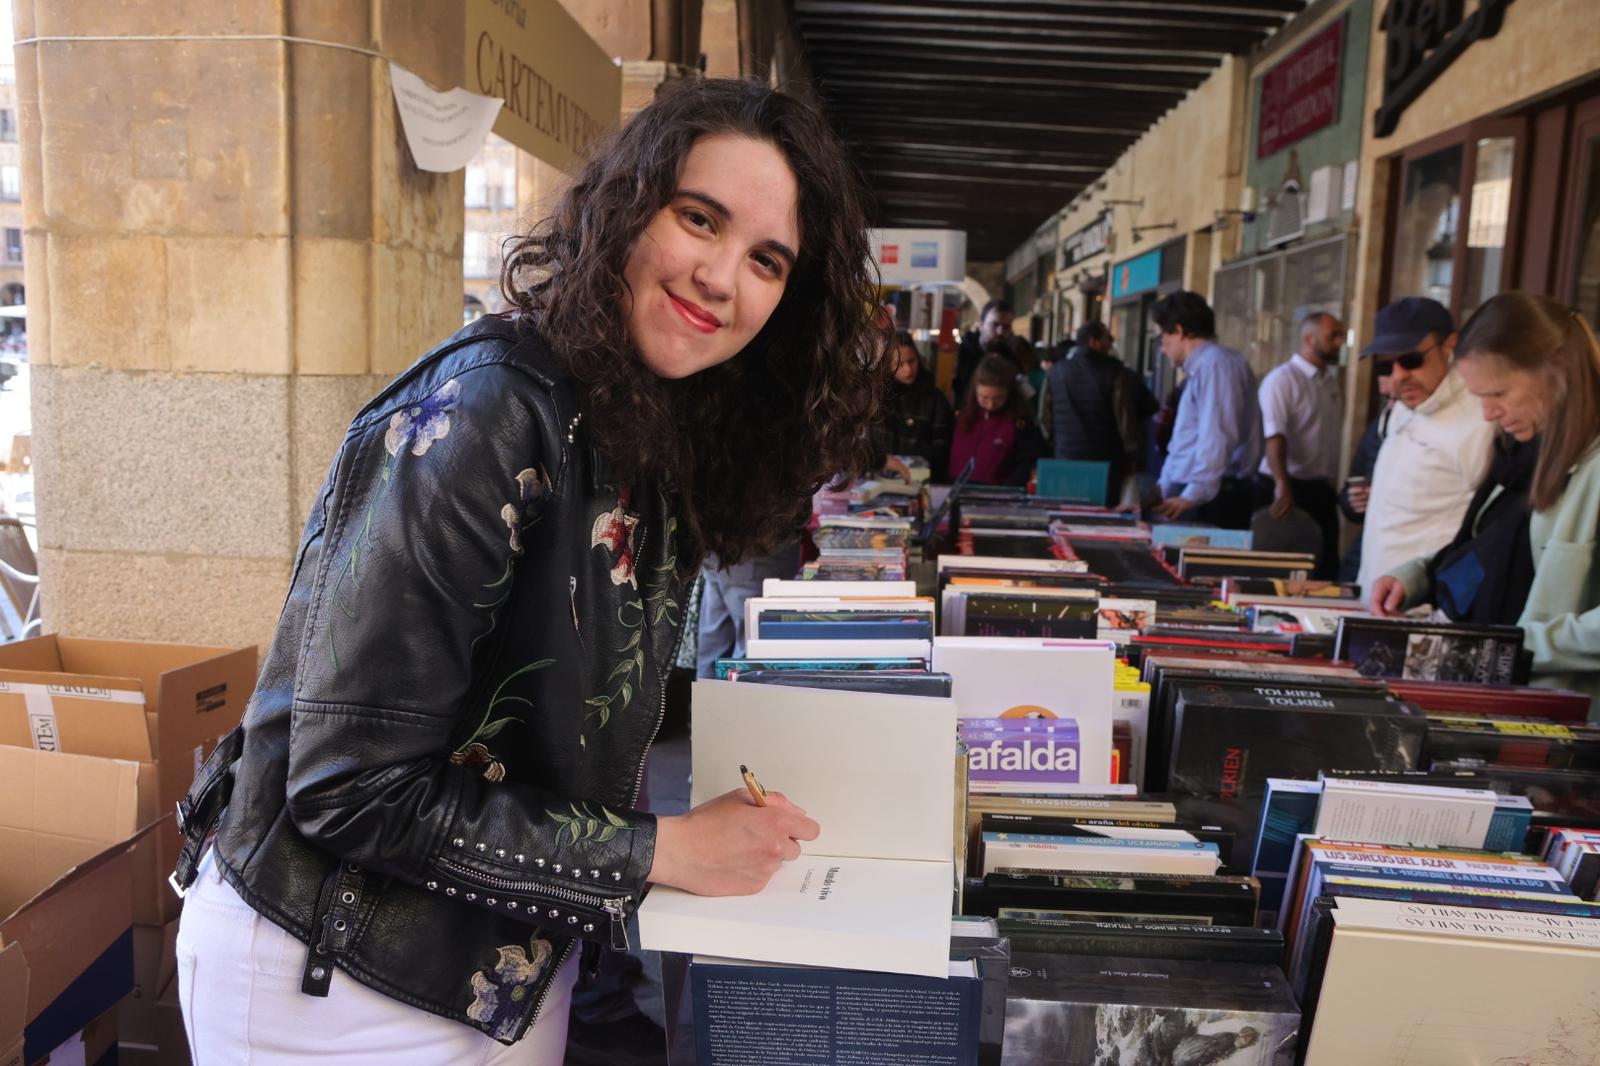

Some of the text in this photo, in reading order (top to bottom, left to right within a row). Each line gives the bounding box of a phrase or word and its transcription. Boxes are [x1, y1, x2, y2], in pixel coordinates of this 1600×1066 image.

[1254, 687, 1321, 698] TOLKIEN
[1265, 697, 1335, 708] TOLKIEN
[969, 740, 1077, 771] afalda
[1324, 850, 1457, 869] LOS SURCOS DEL AZAR
[1382, 867, 1398, 875] EL
